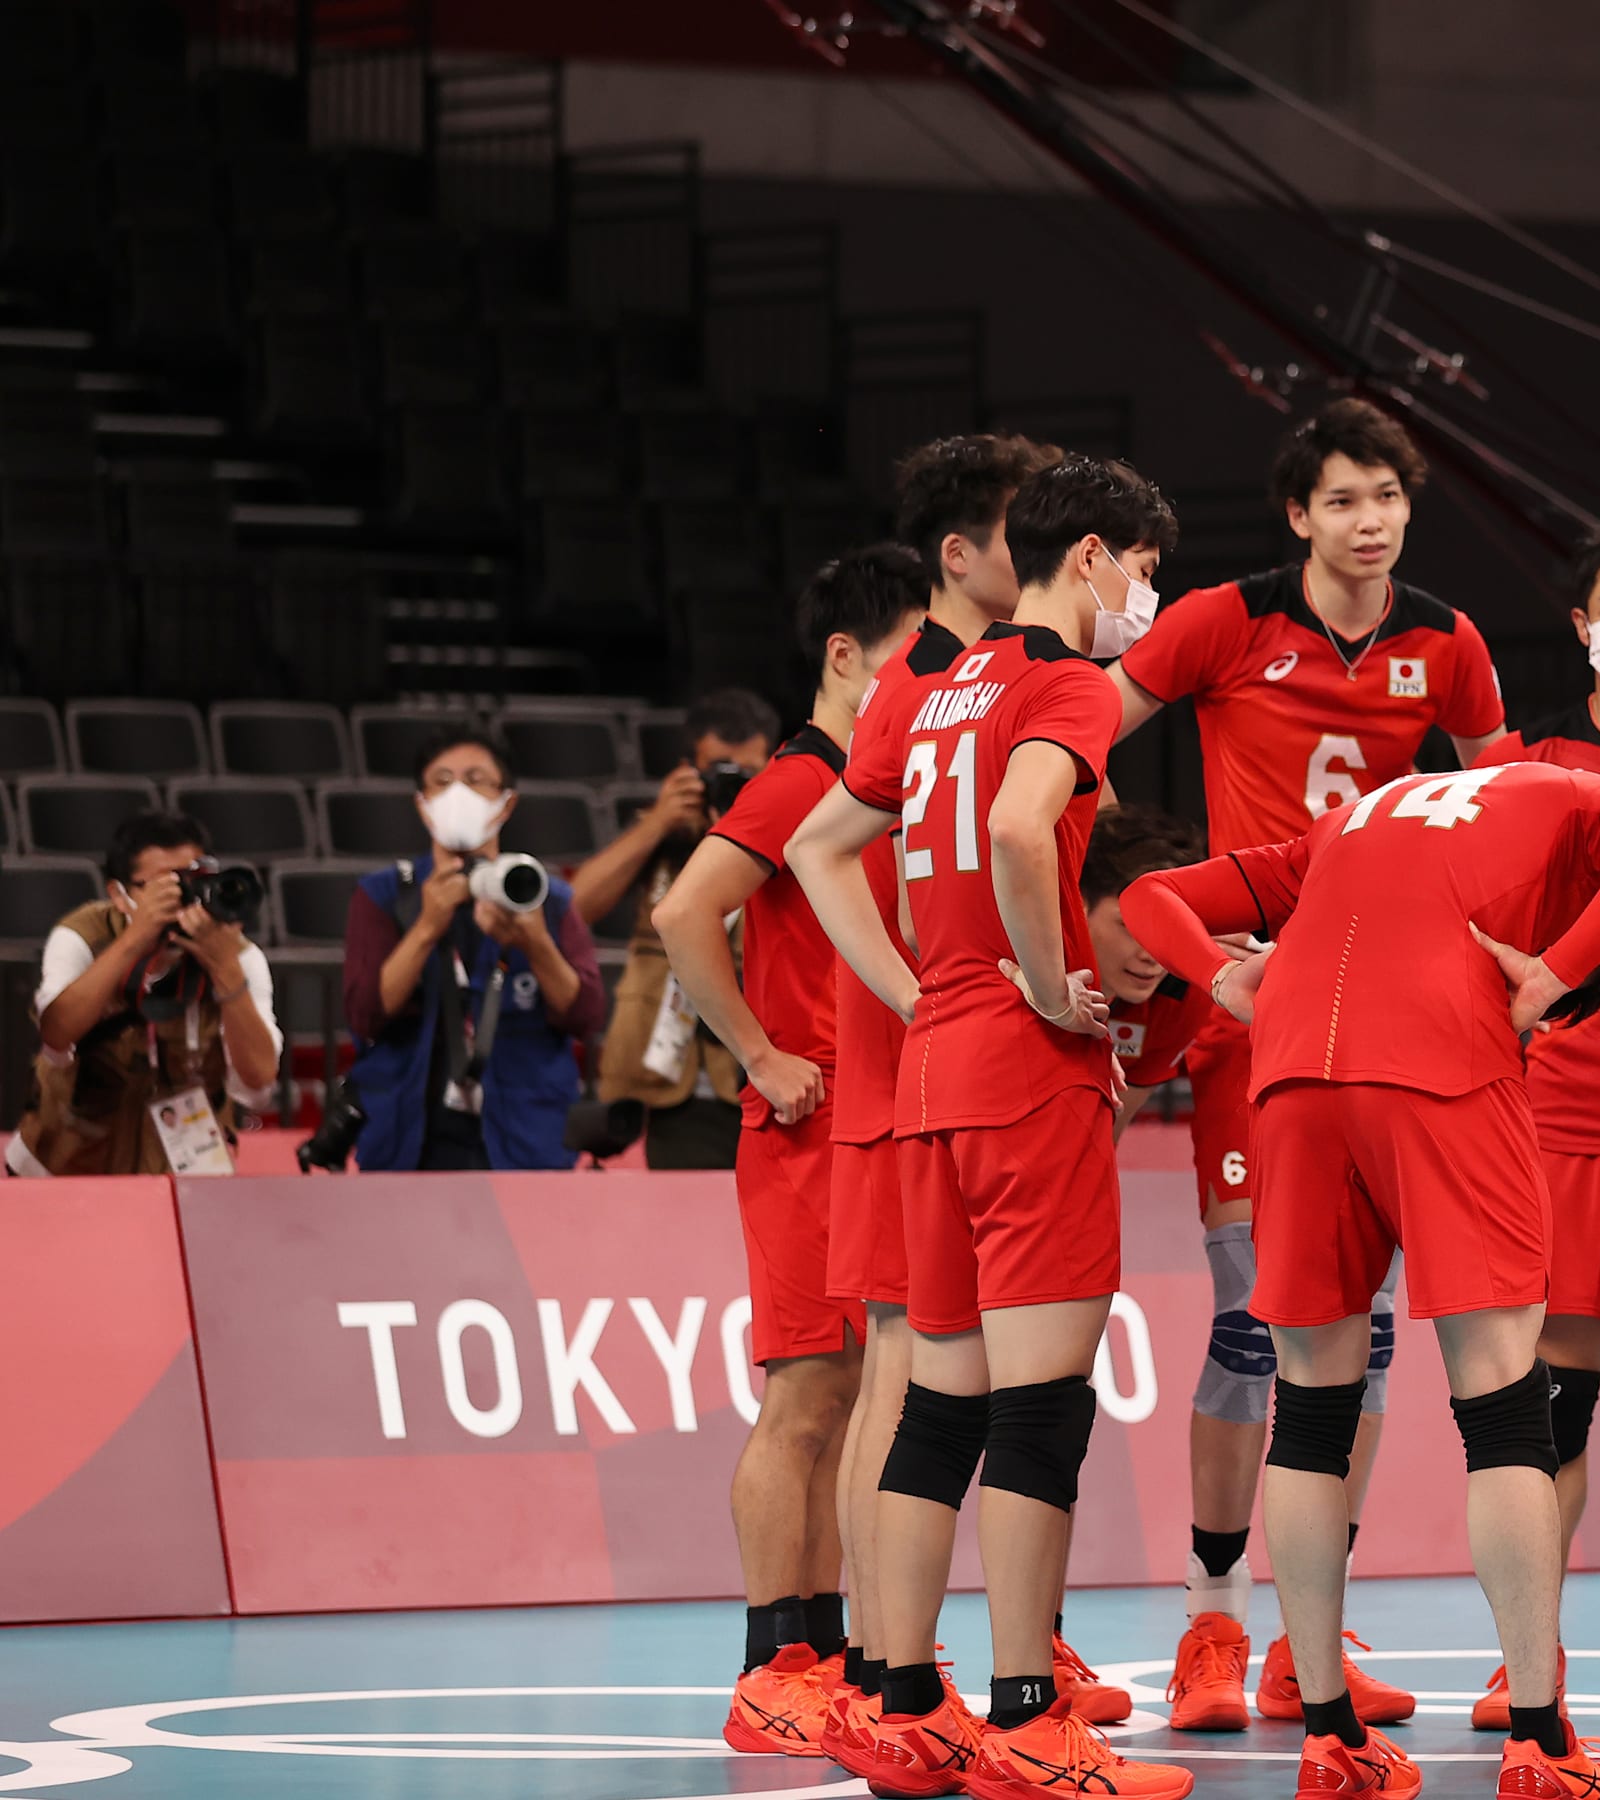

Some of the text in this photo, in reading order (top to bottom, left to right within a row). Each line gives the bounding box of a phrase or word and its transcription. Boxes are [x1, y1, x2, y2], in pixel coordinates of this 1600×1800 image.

[902, 730, 981, 882] 21
[1304, 735, 1367, 821] 6
[1341, 767, 1507, 836] 14
[1222, 1150, 1248, 1187] 6
[1021, 1683, 1042, 1704] 21
